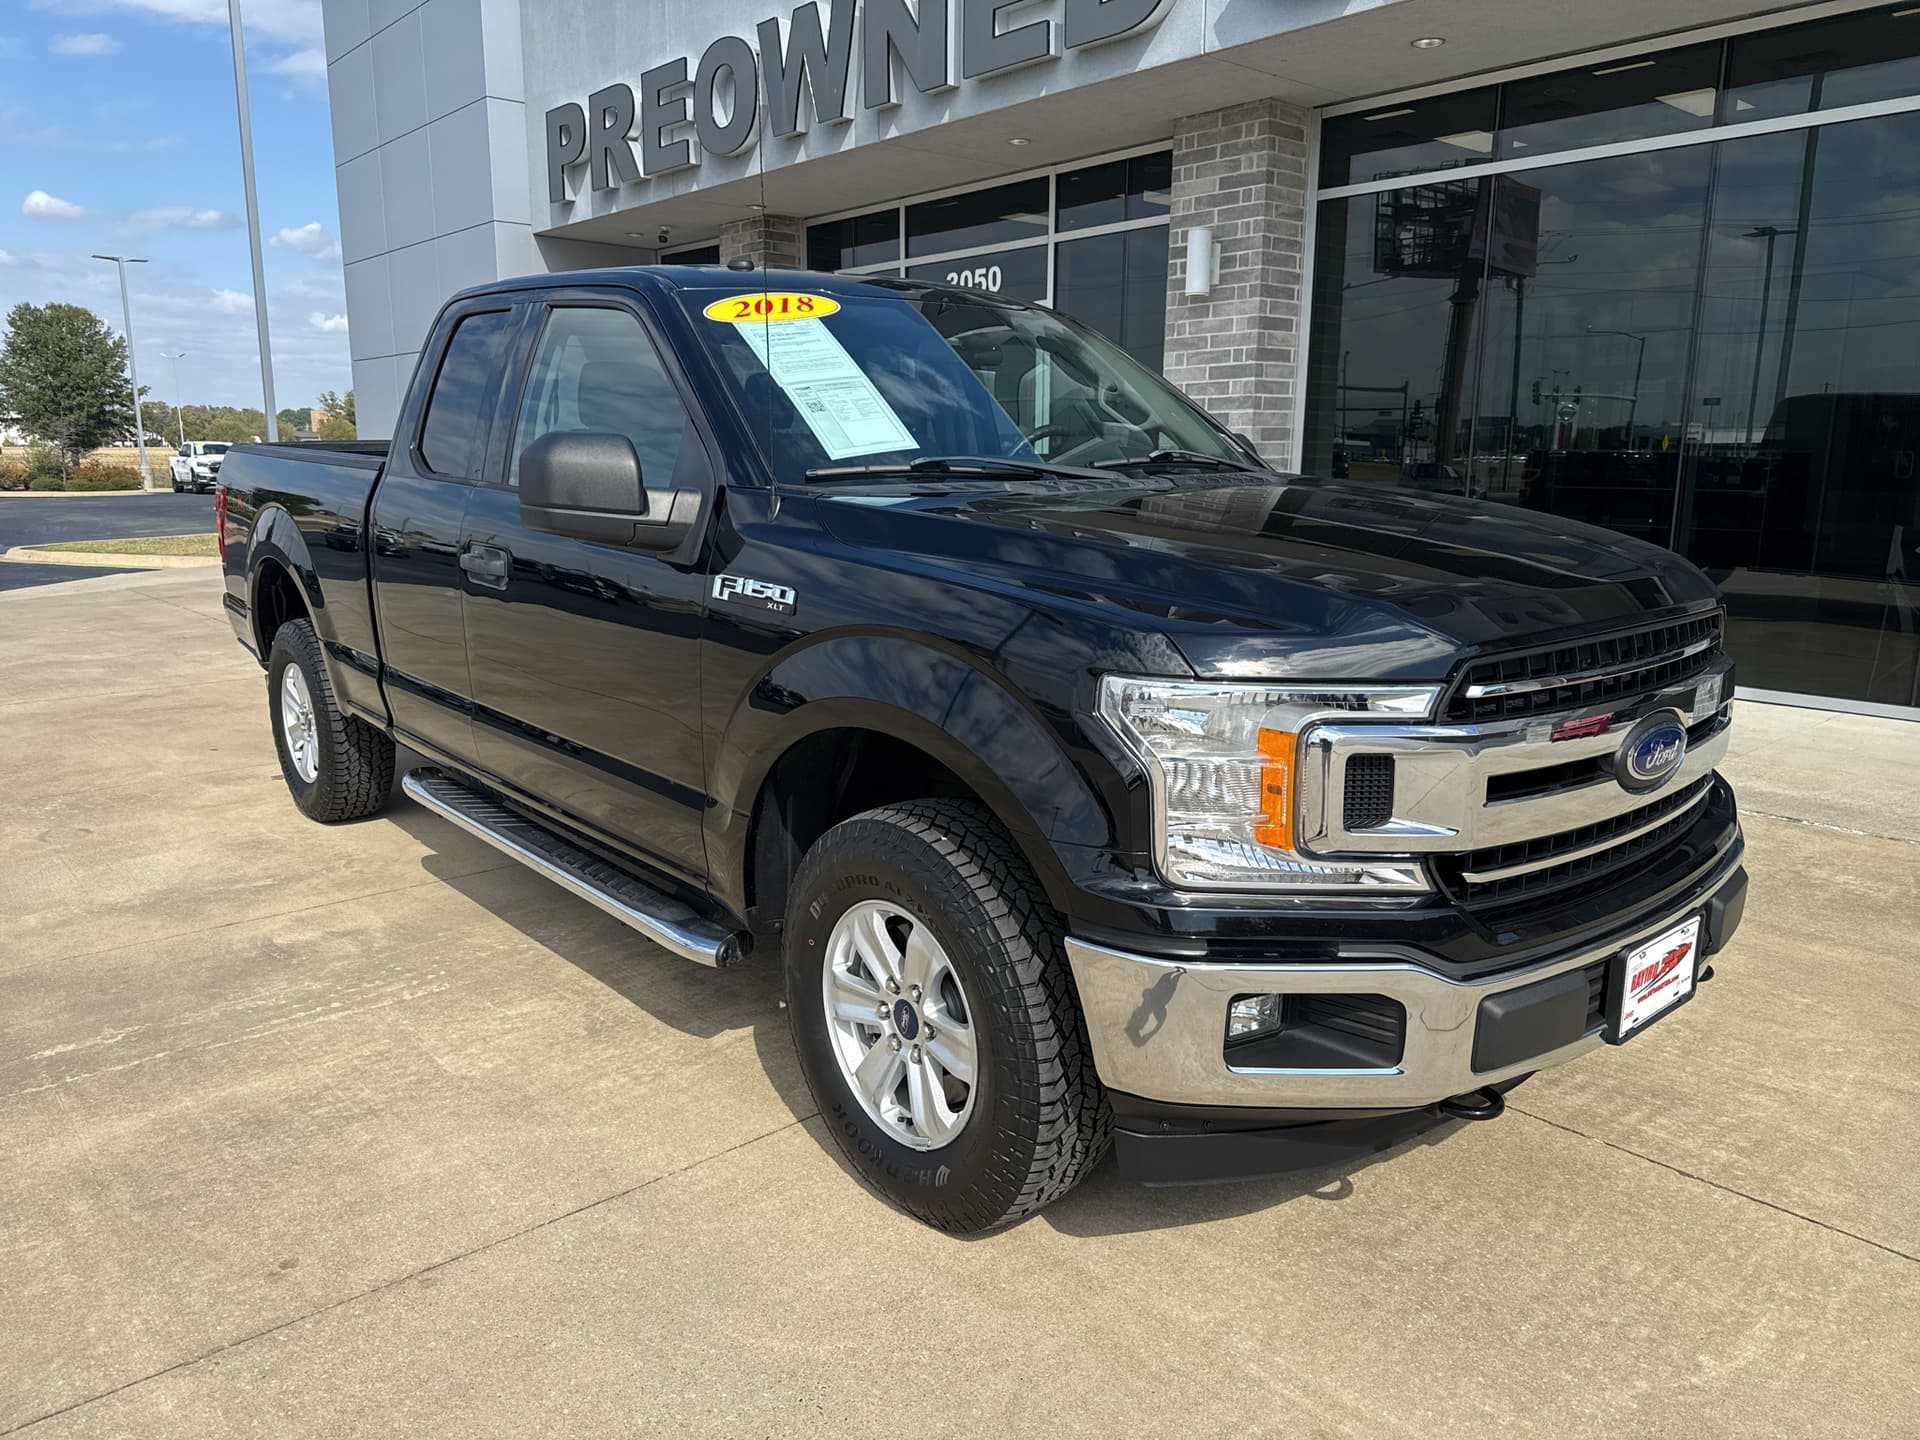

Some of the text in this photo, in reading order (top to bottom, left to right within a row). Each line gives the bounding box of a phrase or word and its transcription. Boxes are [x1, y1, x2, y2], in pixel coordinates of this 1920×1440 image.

[733, 296, 815, 319] 2018
[766, 601, 784, 612] XLT
[1646, 736, 1680, 769] Ford
